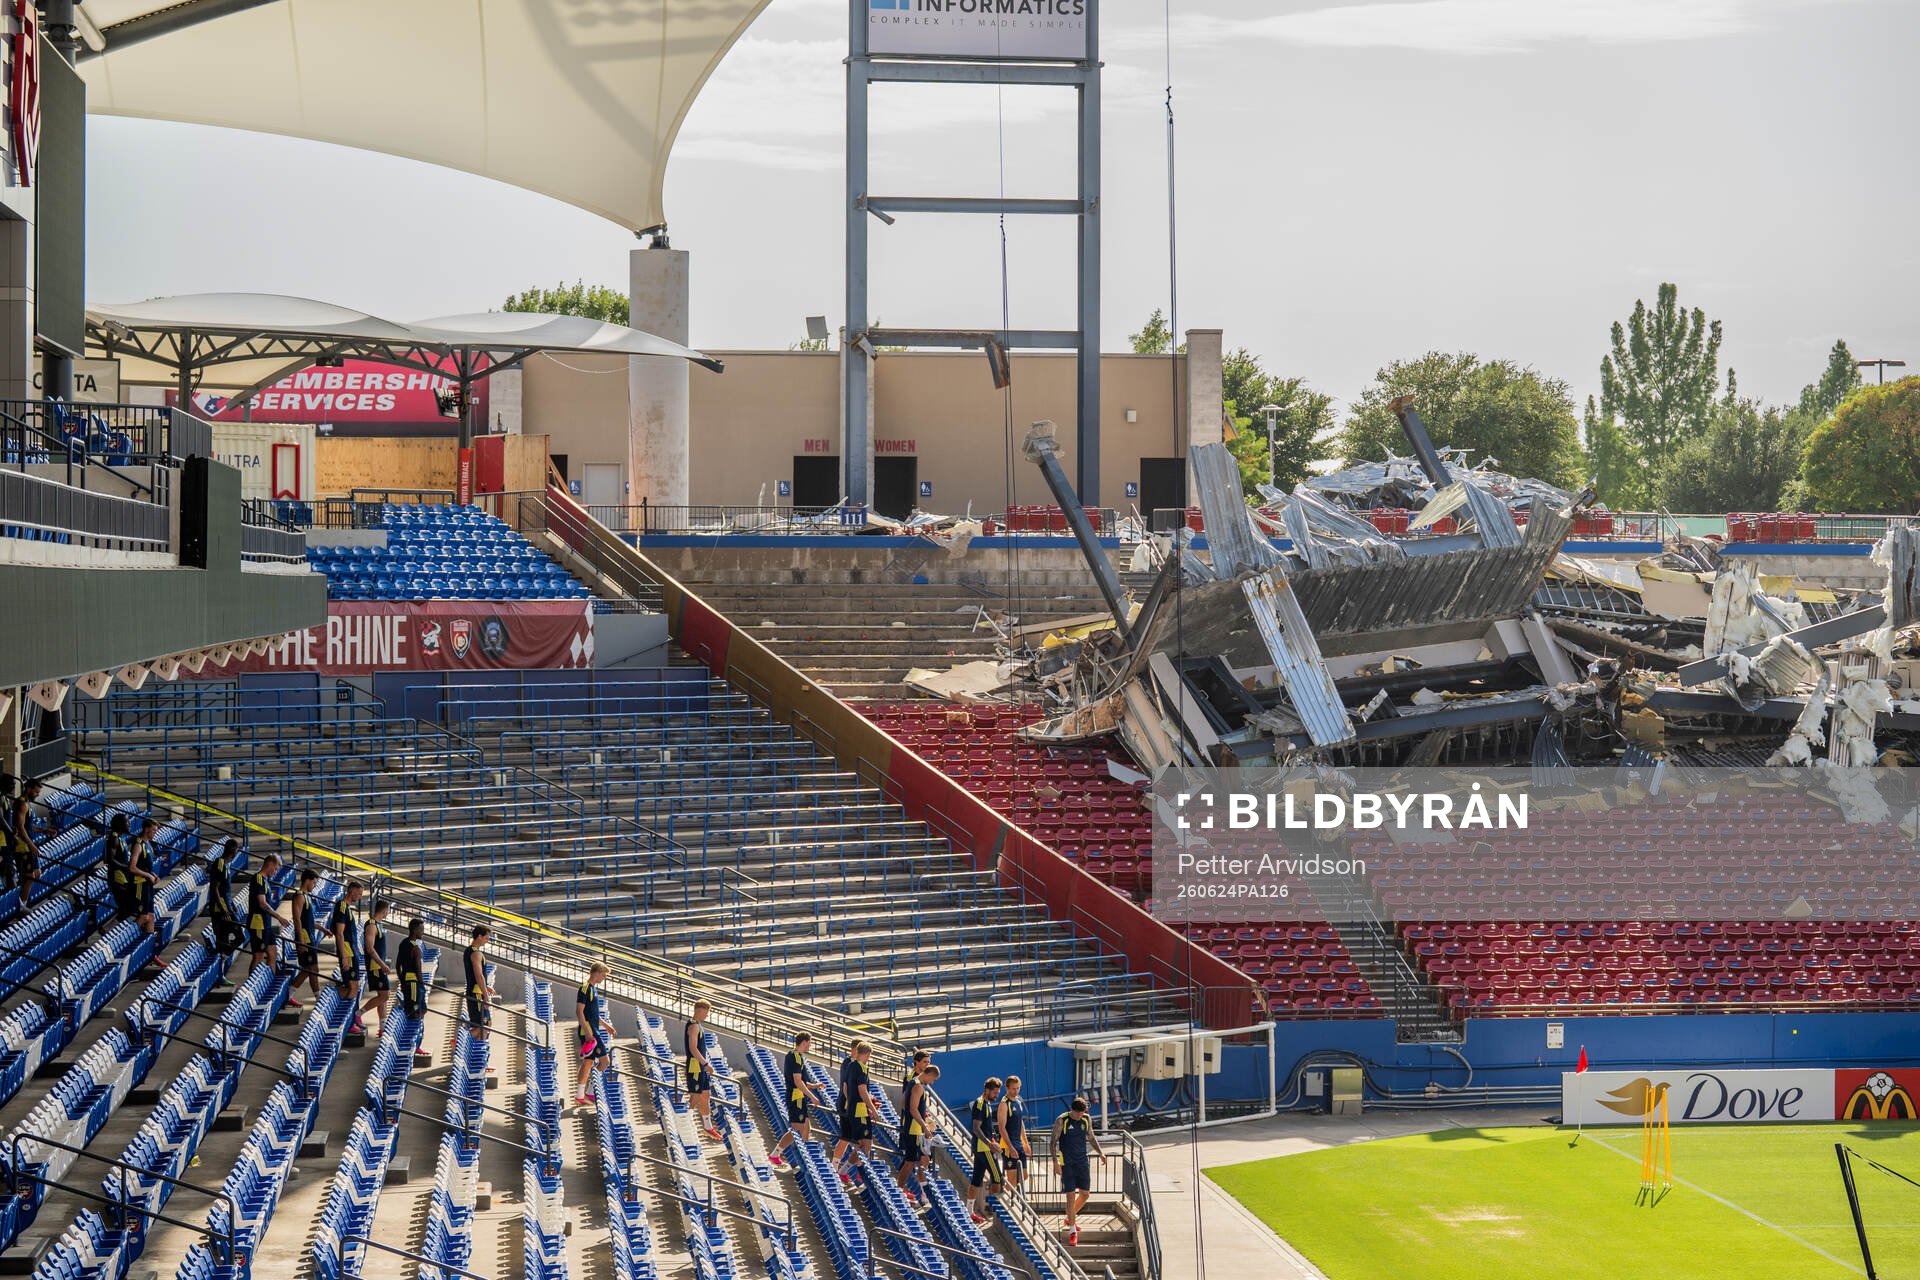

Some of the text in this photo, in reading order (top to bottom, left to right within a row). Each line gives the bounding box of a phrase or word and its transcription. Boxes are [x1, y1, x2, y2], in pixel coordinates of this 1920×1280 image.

[917, 0, 1084, 15] INFORMATICS
[870, 15, 1084, 29] COMPLEX IT MADE SIMPLE
[266, 372, 460, 390] EMBERSHIP
[242, 393, 396, 410] SERVICES
[804, 439, 830, 453] MEN
[874, 439, 916, 453] WOMEN
[461, 461, 469, 483] TERRACE
[844, 513, 864, 526] 111
[327, 615, 407, 665] RHINE
[1682, 1073, 1804, 1120] Dove
